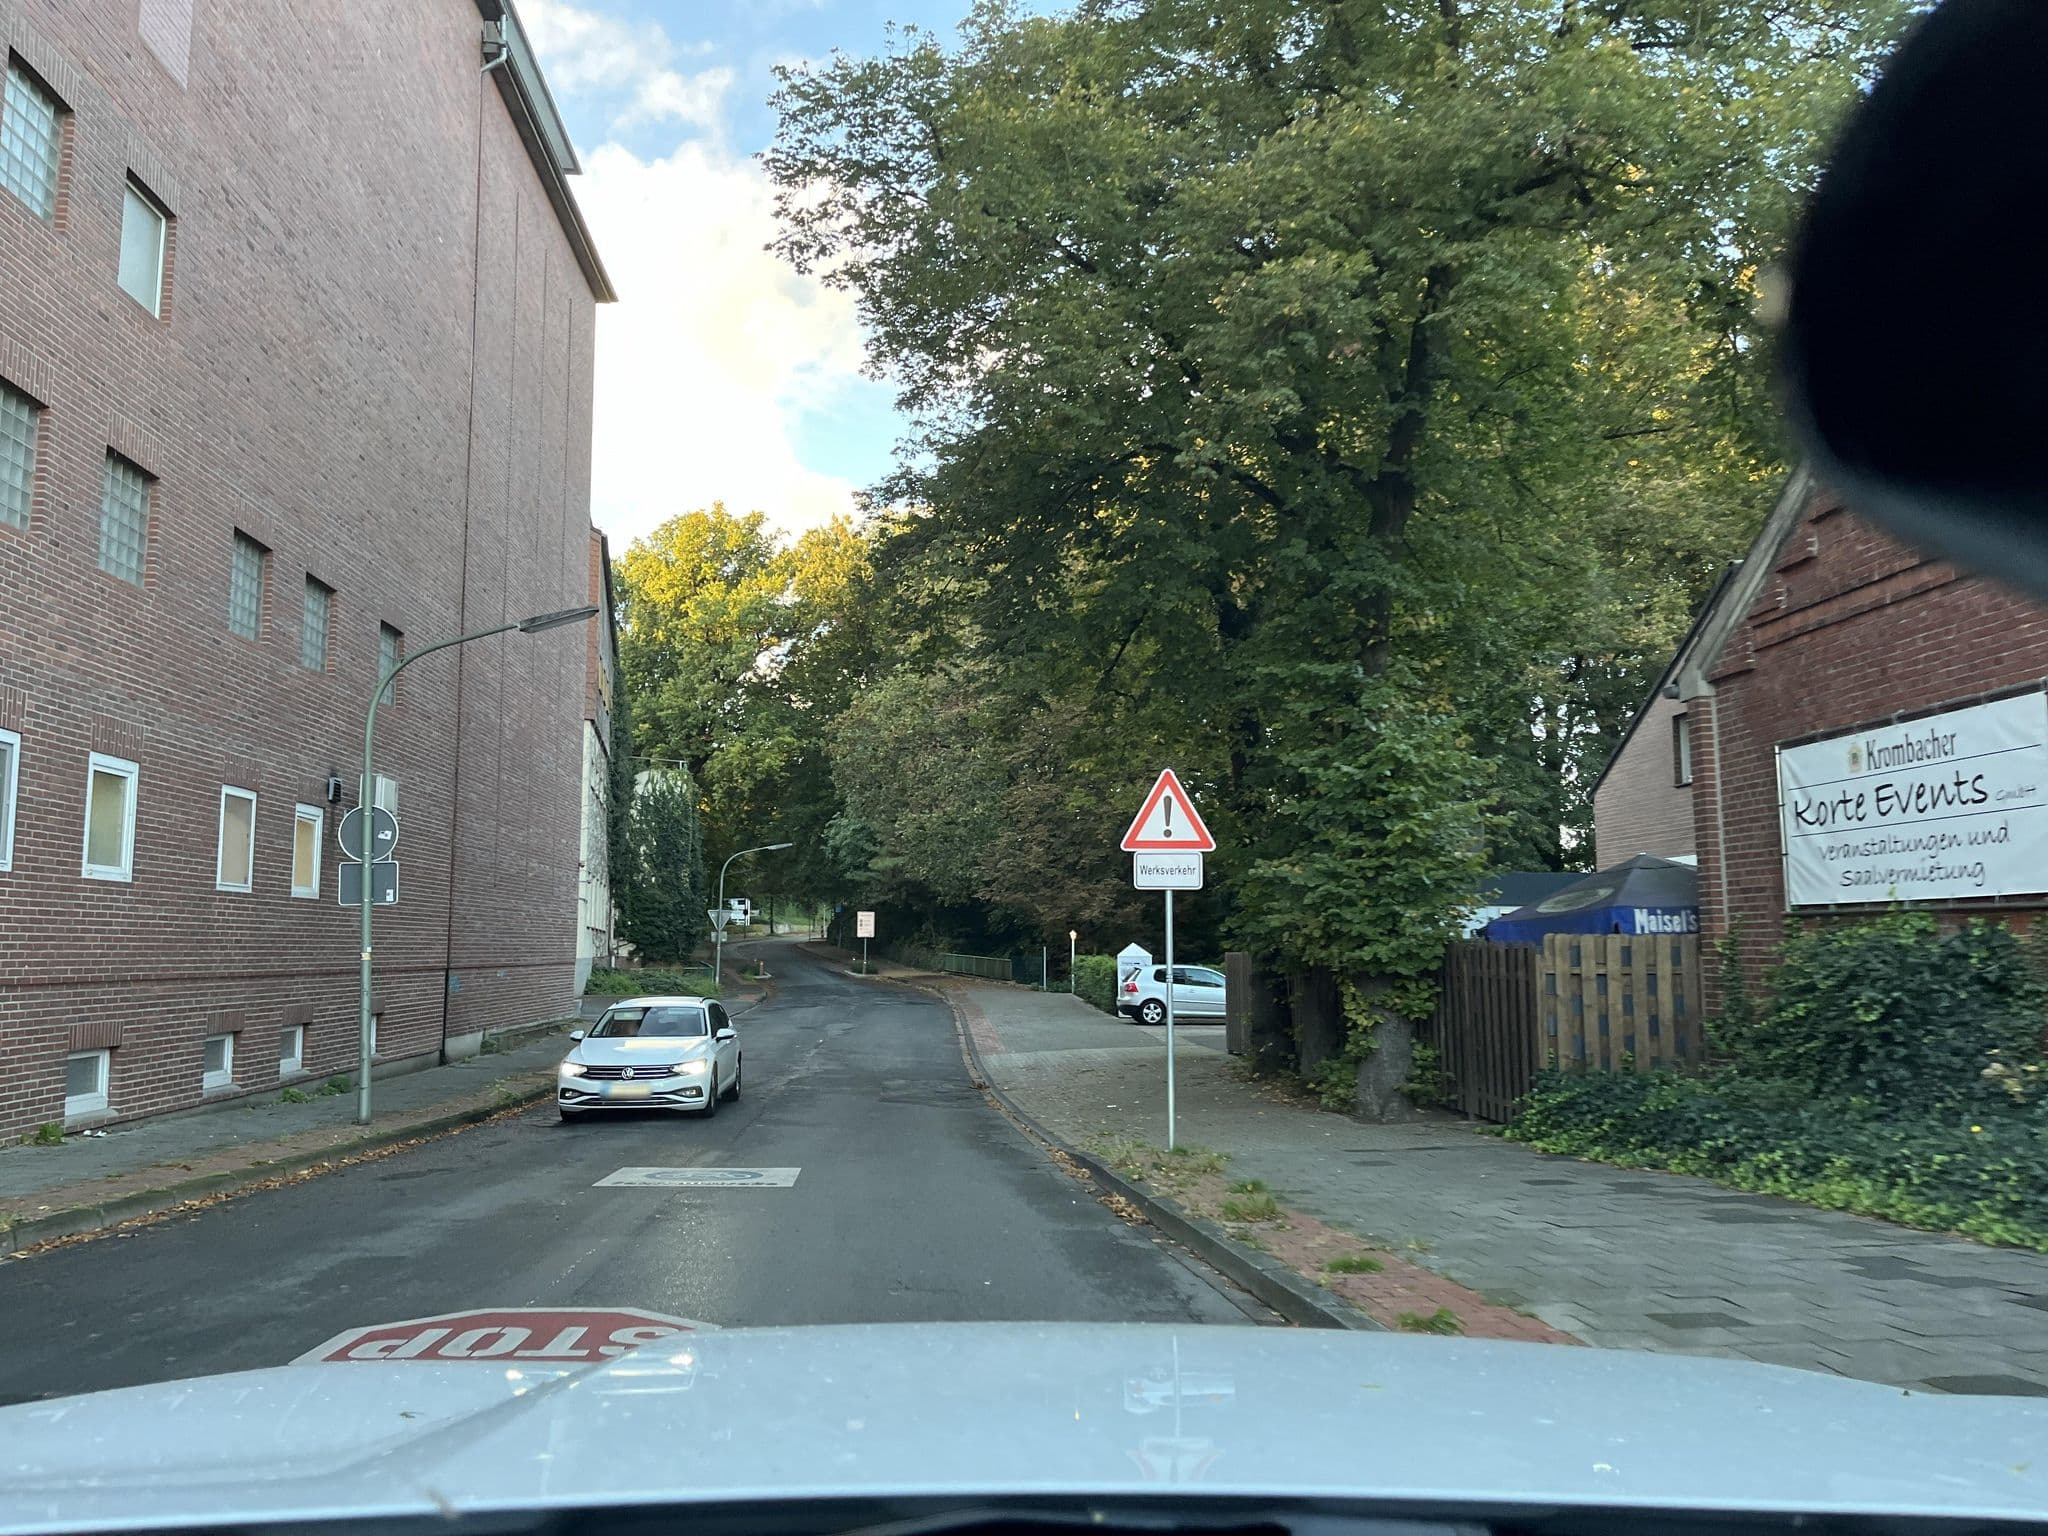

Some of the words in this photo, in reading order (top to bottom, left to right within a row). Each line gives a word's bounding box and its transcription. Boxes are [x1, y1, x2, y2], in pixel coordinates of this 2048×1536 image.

[1866, 728, 1957, 770] Krombacher
[1794, 789, 1868, 830] Korte
[1875, 770, 1989, 817] Events
[1967, 818, 2010, 846] und
[1139, 864, 1197, 876] Werksverkehr
